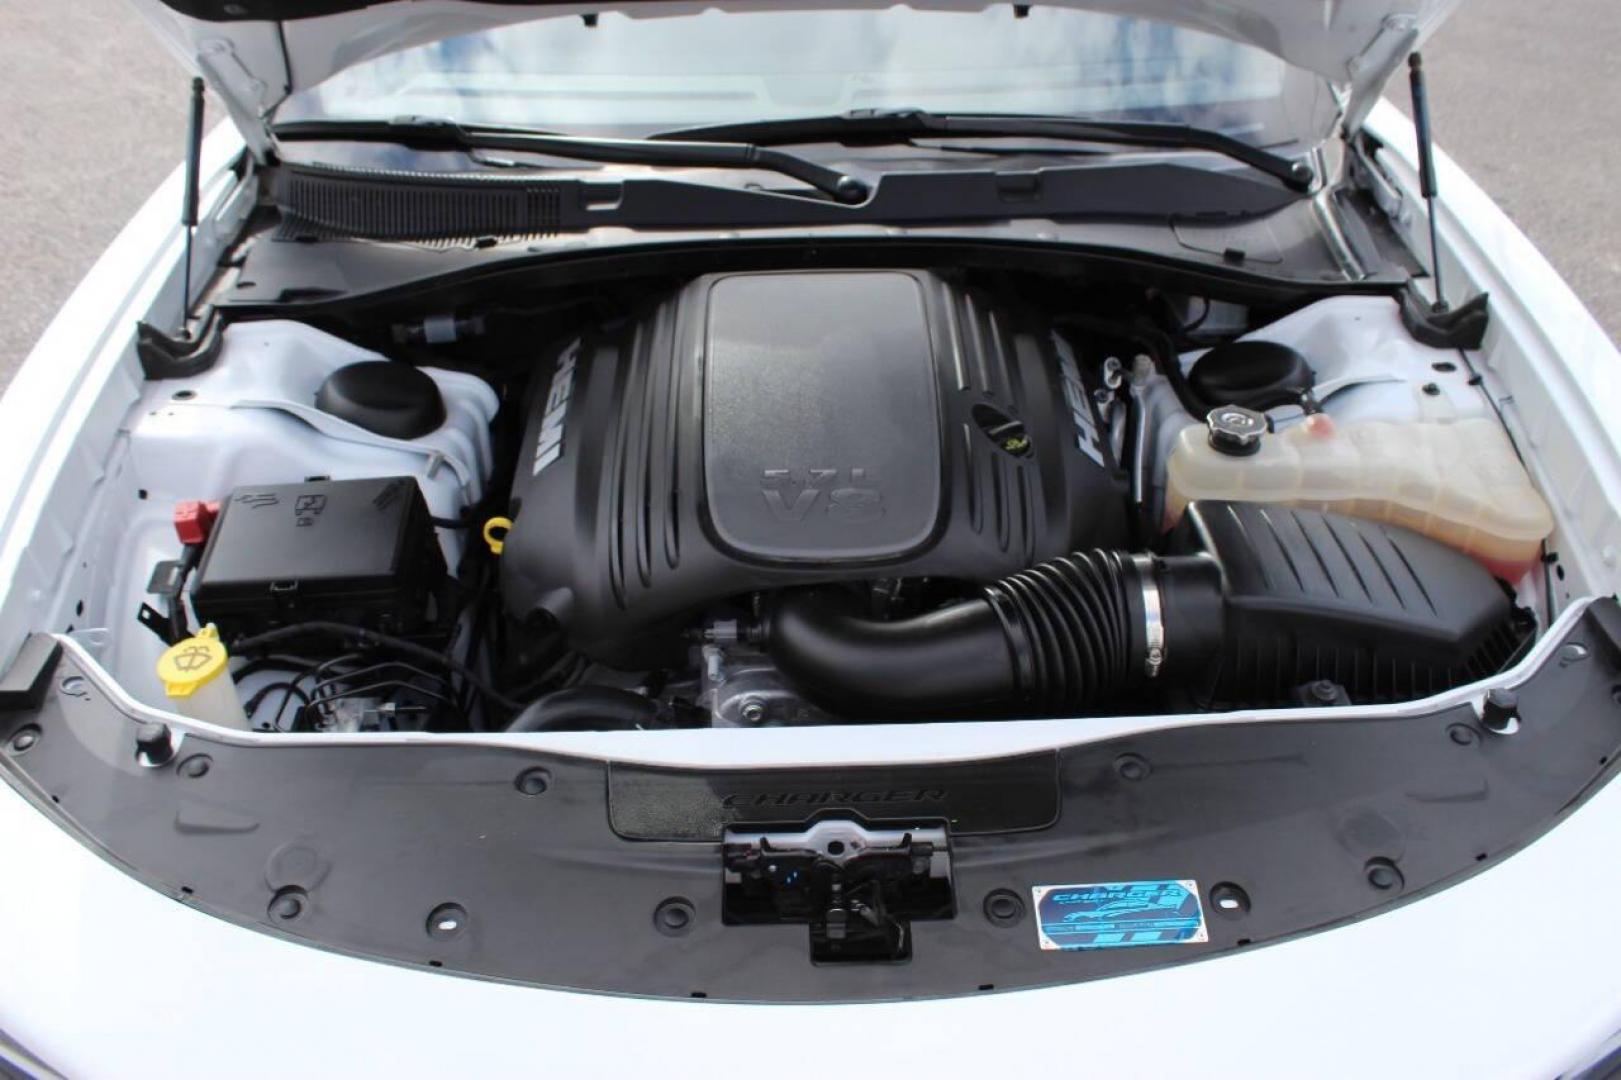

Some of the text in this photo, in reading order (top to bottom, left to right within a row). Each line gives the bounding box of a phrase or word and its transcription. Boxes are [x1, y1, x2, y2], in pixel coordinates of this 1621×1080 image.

[532, 337, 581, 476] HEMI
[722, 788, 949, 808] CHARGER
[1052, 889, 1184, 901] CHARGER
